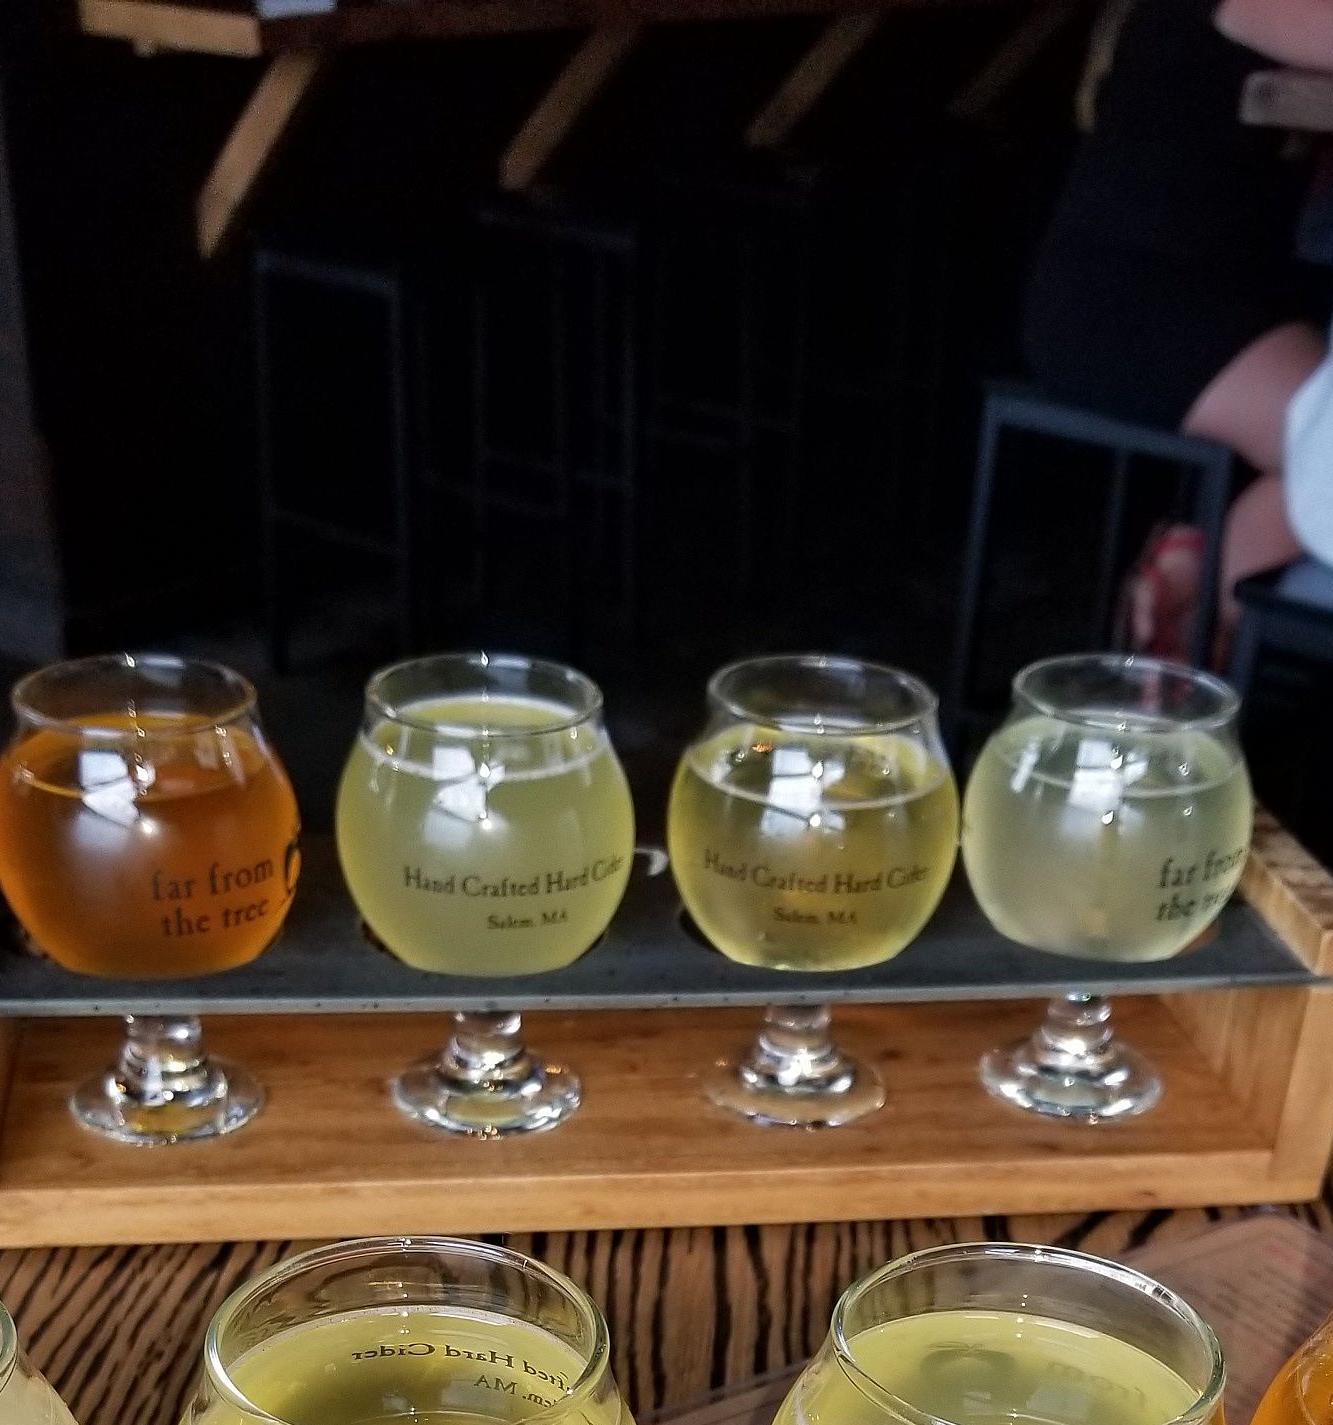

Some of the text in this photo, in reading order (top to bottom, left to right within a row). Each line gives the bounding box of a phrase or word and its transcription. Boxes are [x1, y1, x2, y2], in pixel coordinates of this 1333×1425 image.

[152, 859, 275, 901] far from
[403, 865, 455, 894] Hand
[461, 874, 539, 898] Crafted
[545, 867, 590, 895] Hard
[162, 899, 270, 937] the tree
